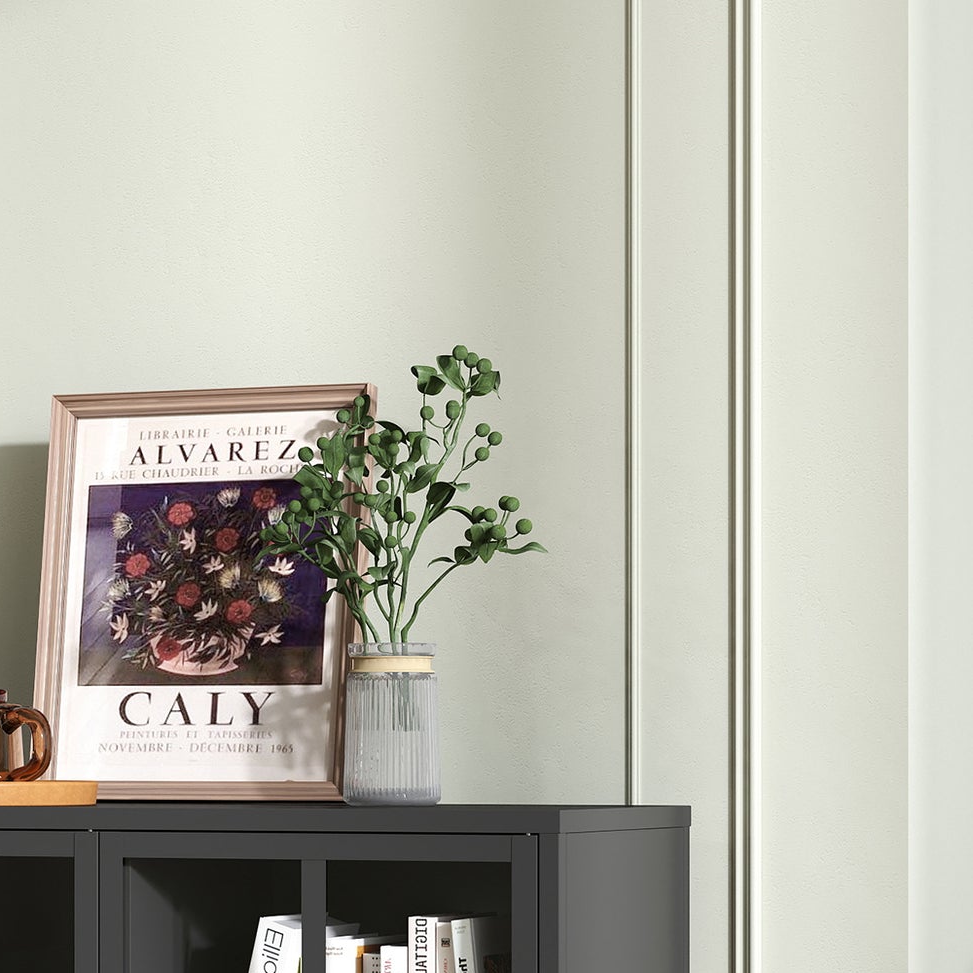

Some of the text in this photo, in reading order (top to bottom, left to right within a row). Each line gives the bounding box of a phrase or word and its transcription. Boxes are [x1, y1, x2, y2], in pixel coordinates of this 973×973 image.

[139, 424, 288, 440] LIBRAIRIE GALERIE
[128, 439, 297, 466] ALVAREZ
[112, 468, 136, 480] RUE
[142, 466, 220, 479] CHAUDRIER
[238, 464, 254, 476] LA
[260, 462, 302, 474] ROCH
[118, 691, 276, 726] CALY
[120, 730, 274, 739] PEINTURES ET TAPISSERIES
[98, 741, 294, 754] NOVEMBRE DÉCEMBRE 1965
